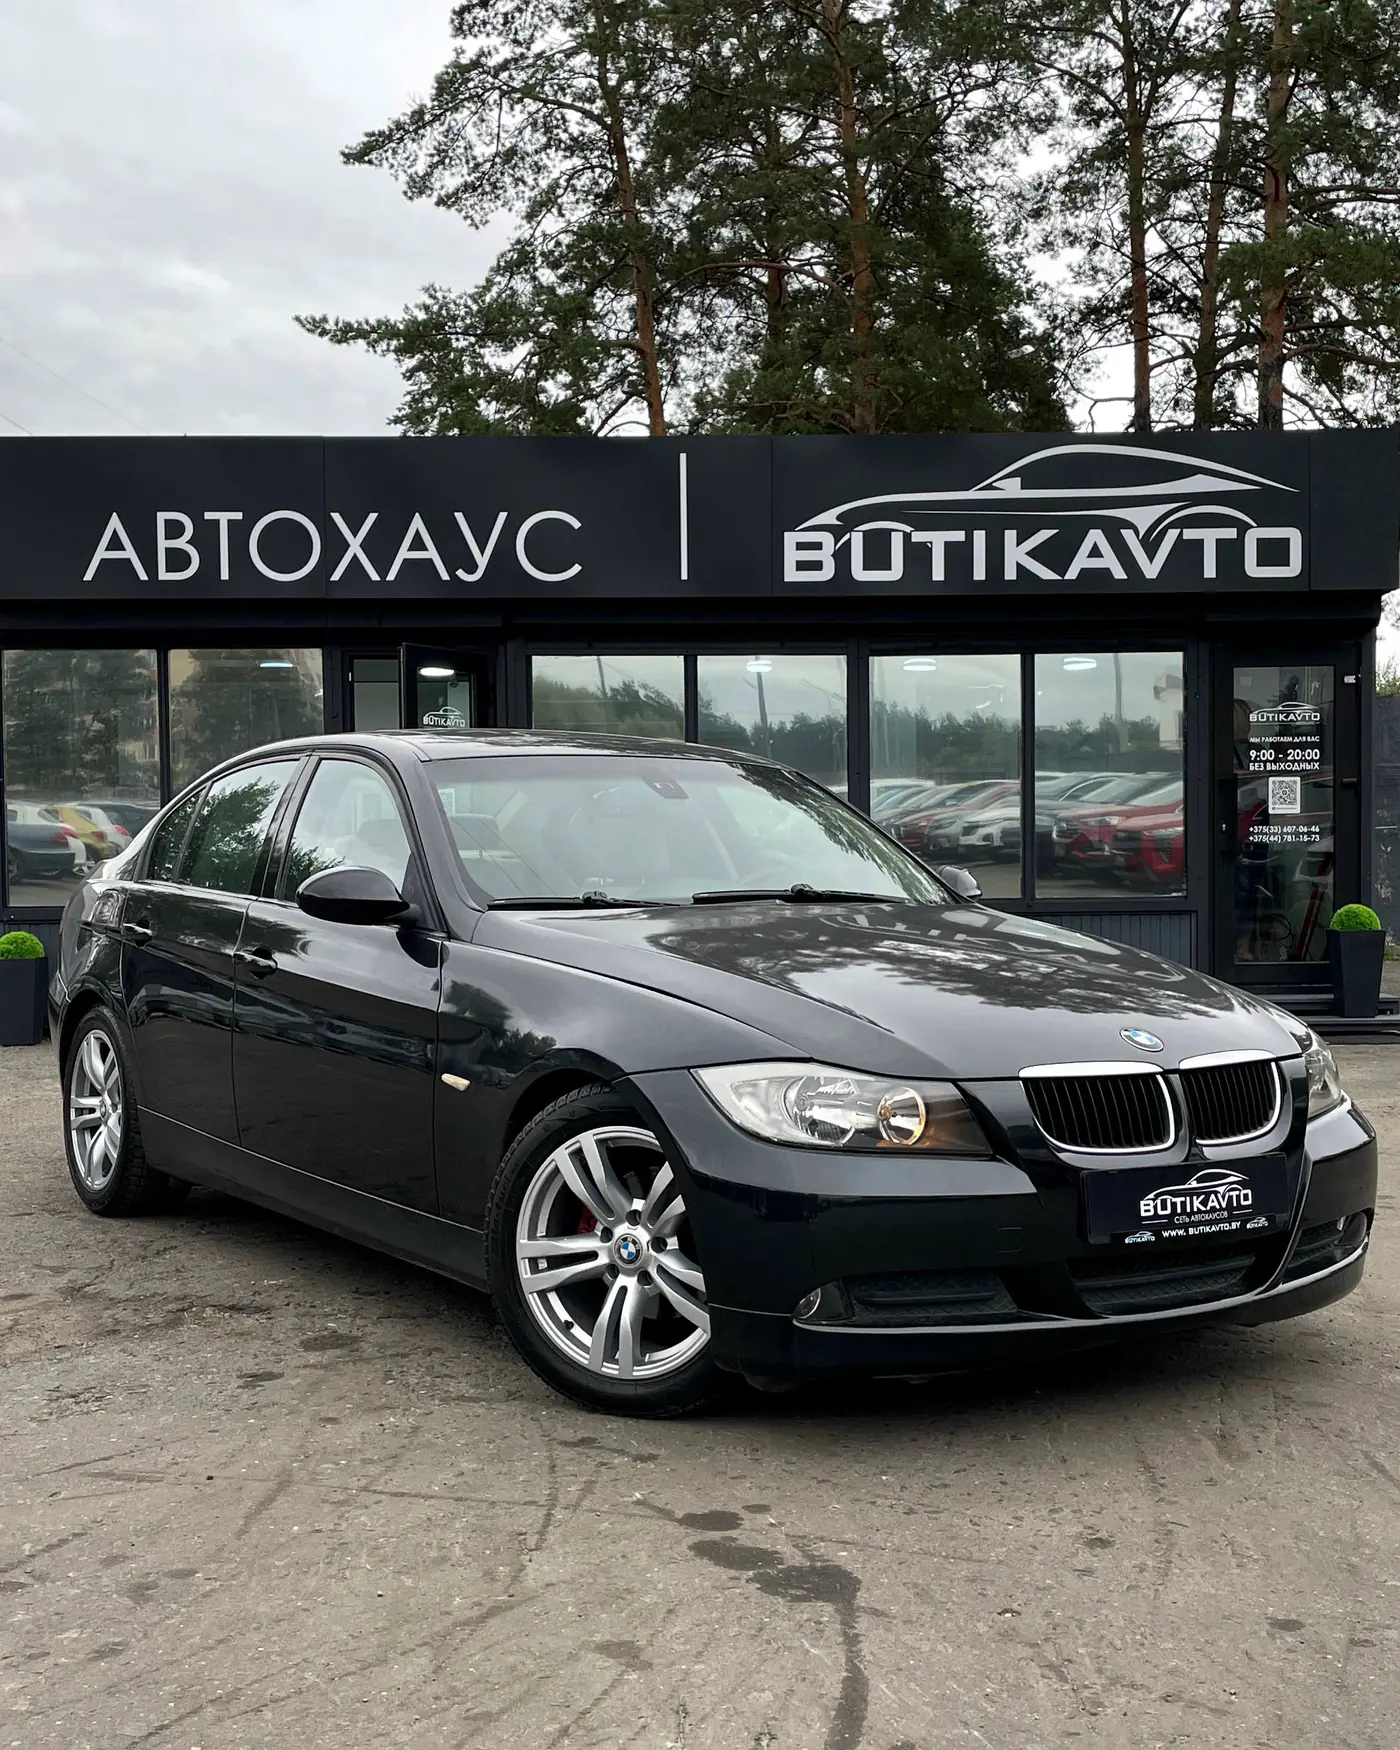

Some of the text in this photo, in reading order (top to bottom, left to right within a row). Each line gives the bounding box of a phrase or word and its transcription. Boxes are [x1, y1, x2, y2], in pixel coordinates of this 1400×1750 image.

[83, 510, 583, 582] АВТОХАУС
[783, 526, 1303, 582] BUTIKAVTO
[423, 716, 466, 727] BUTIKAVTO
[1249, 712, 1320, 722] BUTIKAVTO
[1249, 749, 1275, 761] 9:00
[1287, 749, 1320, 760] 20:00
[1249, 762, 1320, 771] БЕЗ ВЫХОДНЫХ
[1249, 825, 1320, 834] +375(33) 607-06-46
[1249, 834, 1320, 844] +375(44) 781-15-73
[1140, 1188, 1253, 1217] BUTIKAVTO
